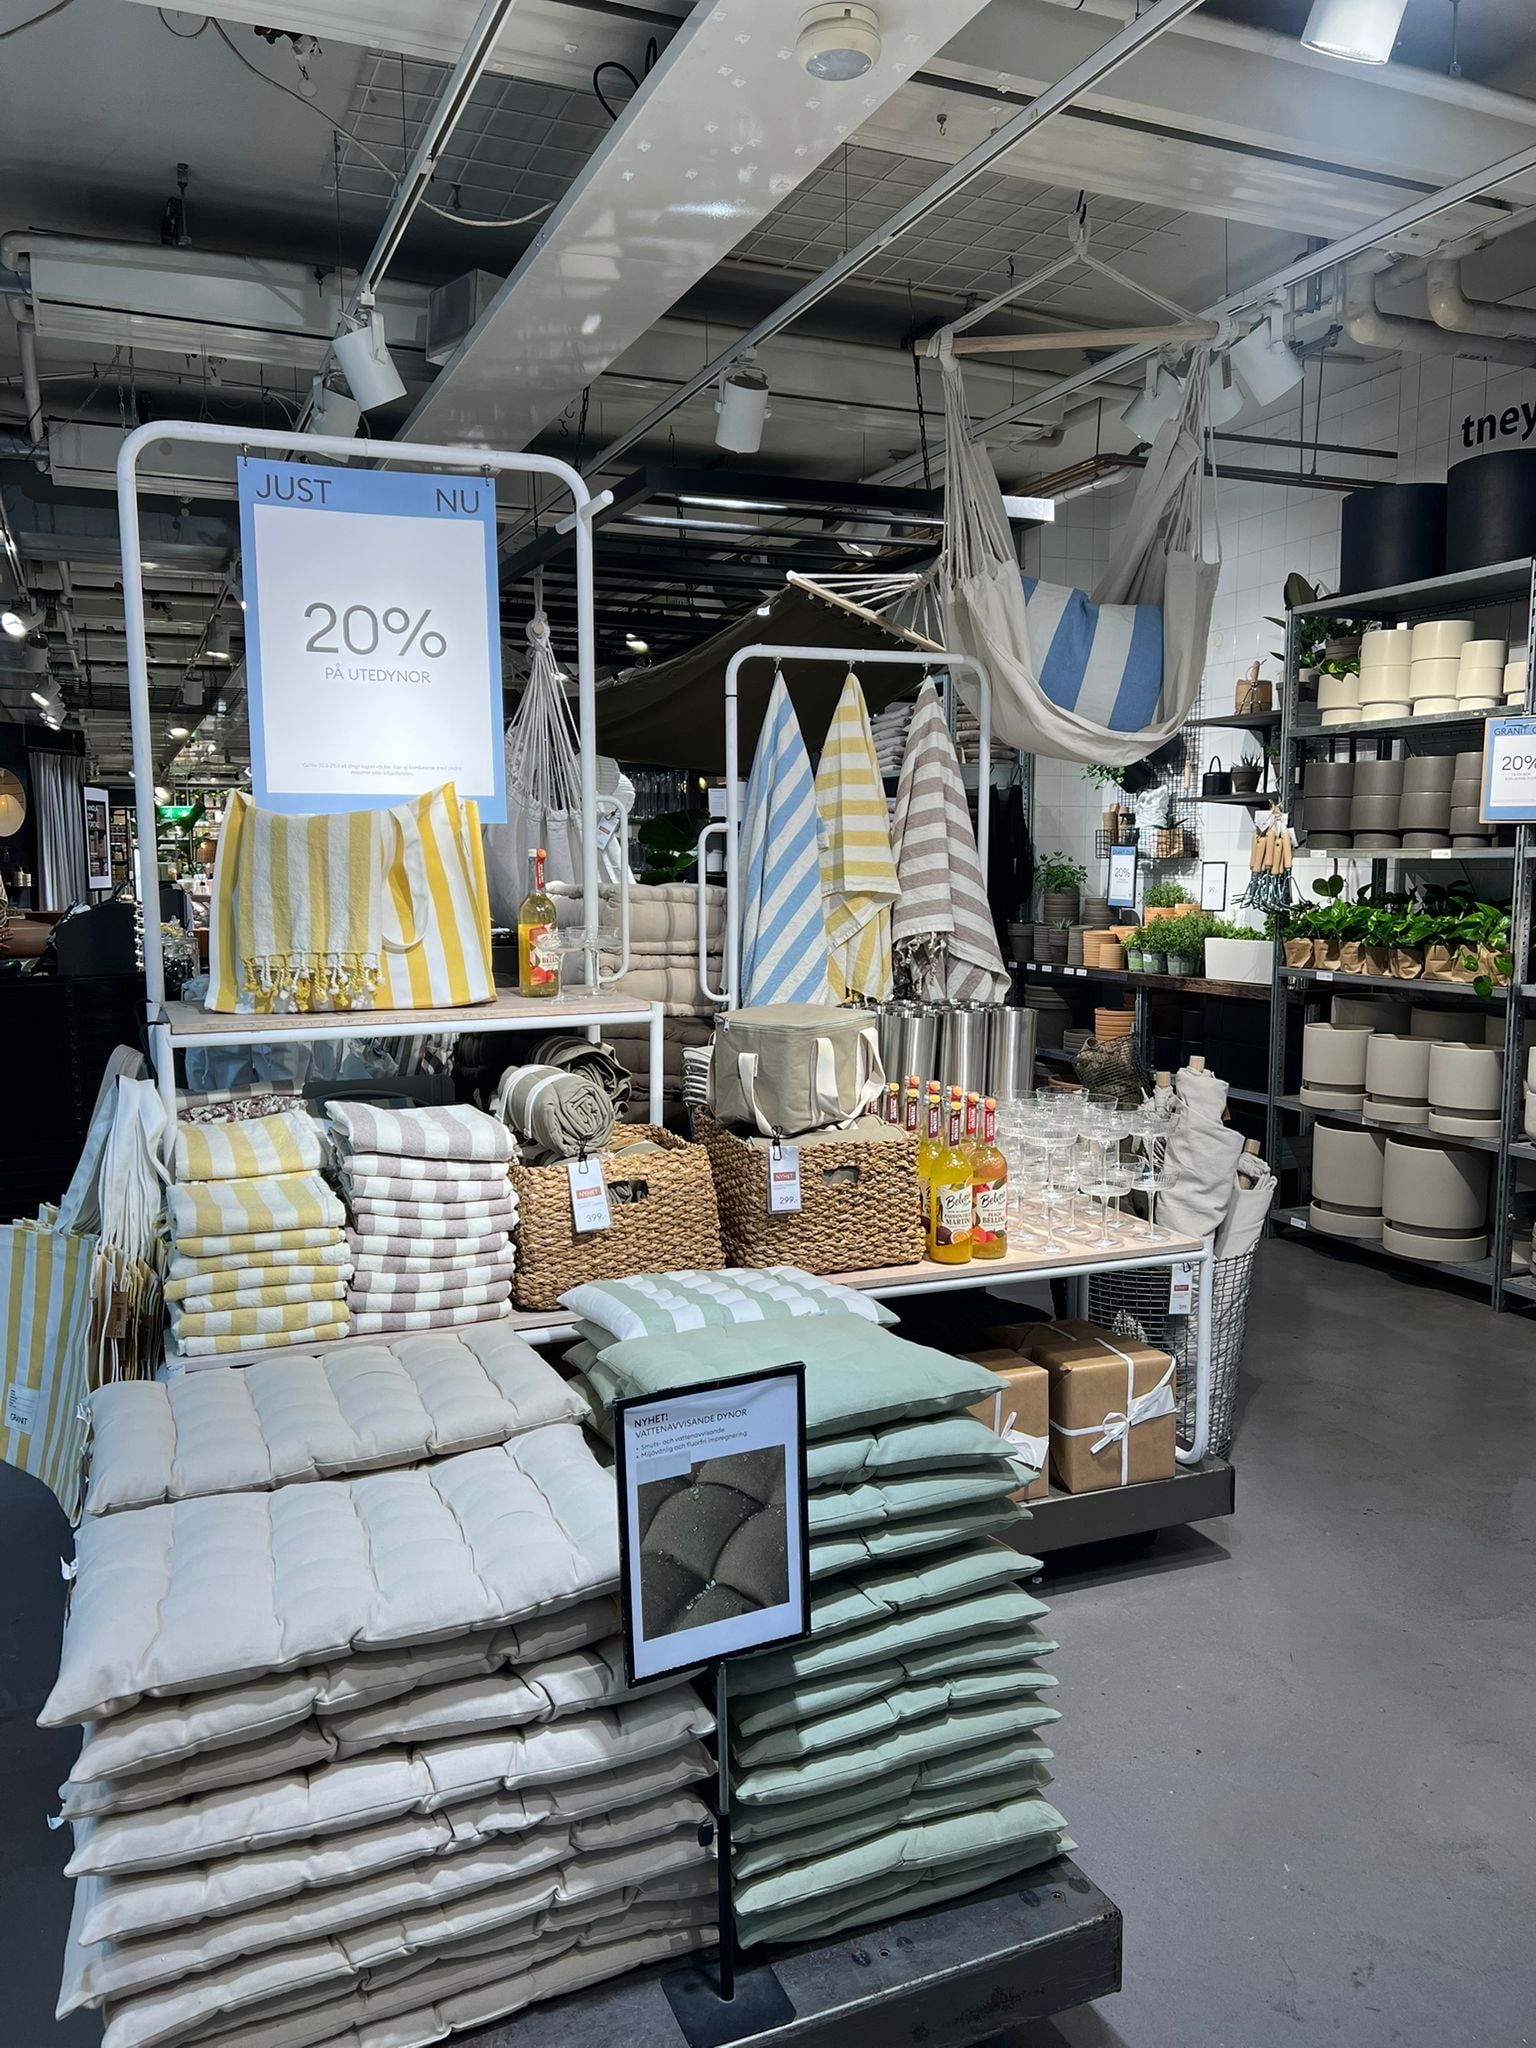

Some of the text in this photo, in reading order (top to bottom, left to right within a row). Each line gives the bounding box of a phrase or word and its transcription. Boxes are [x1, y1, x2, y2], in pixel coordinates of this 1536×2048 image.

[255, 473, 480, 515] JUST NU
[303, 601, 448, 659] 20%
[324, 662, 432, 684] PÅ UTEDYNOR
[633, 1412, 669, 1428] NYHET!
[635, 1408, 748, 1438] VATTENAVVISANDE DYNOR
